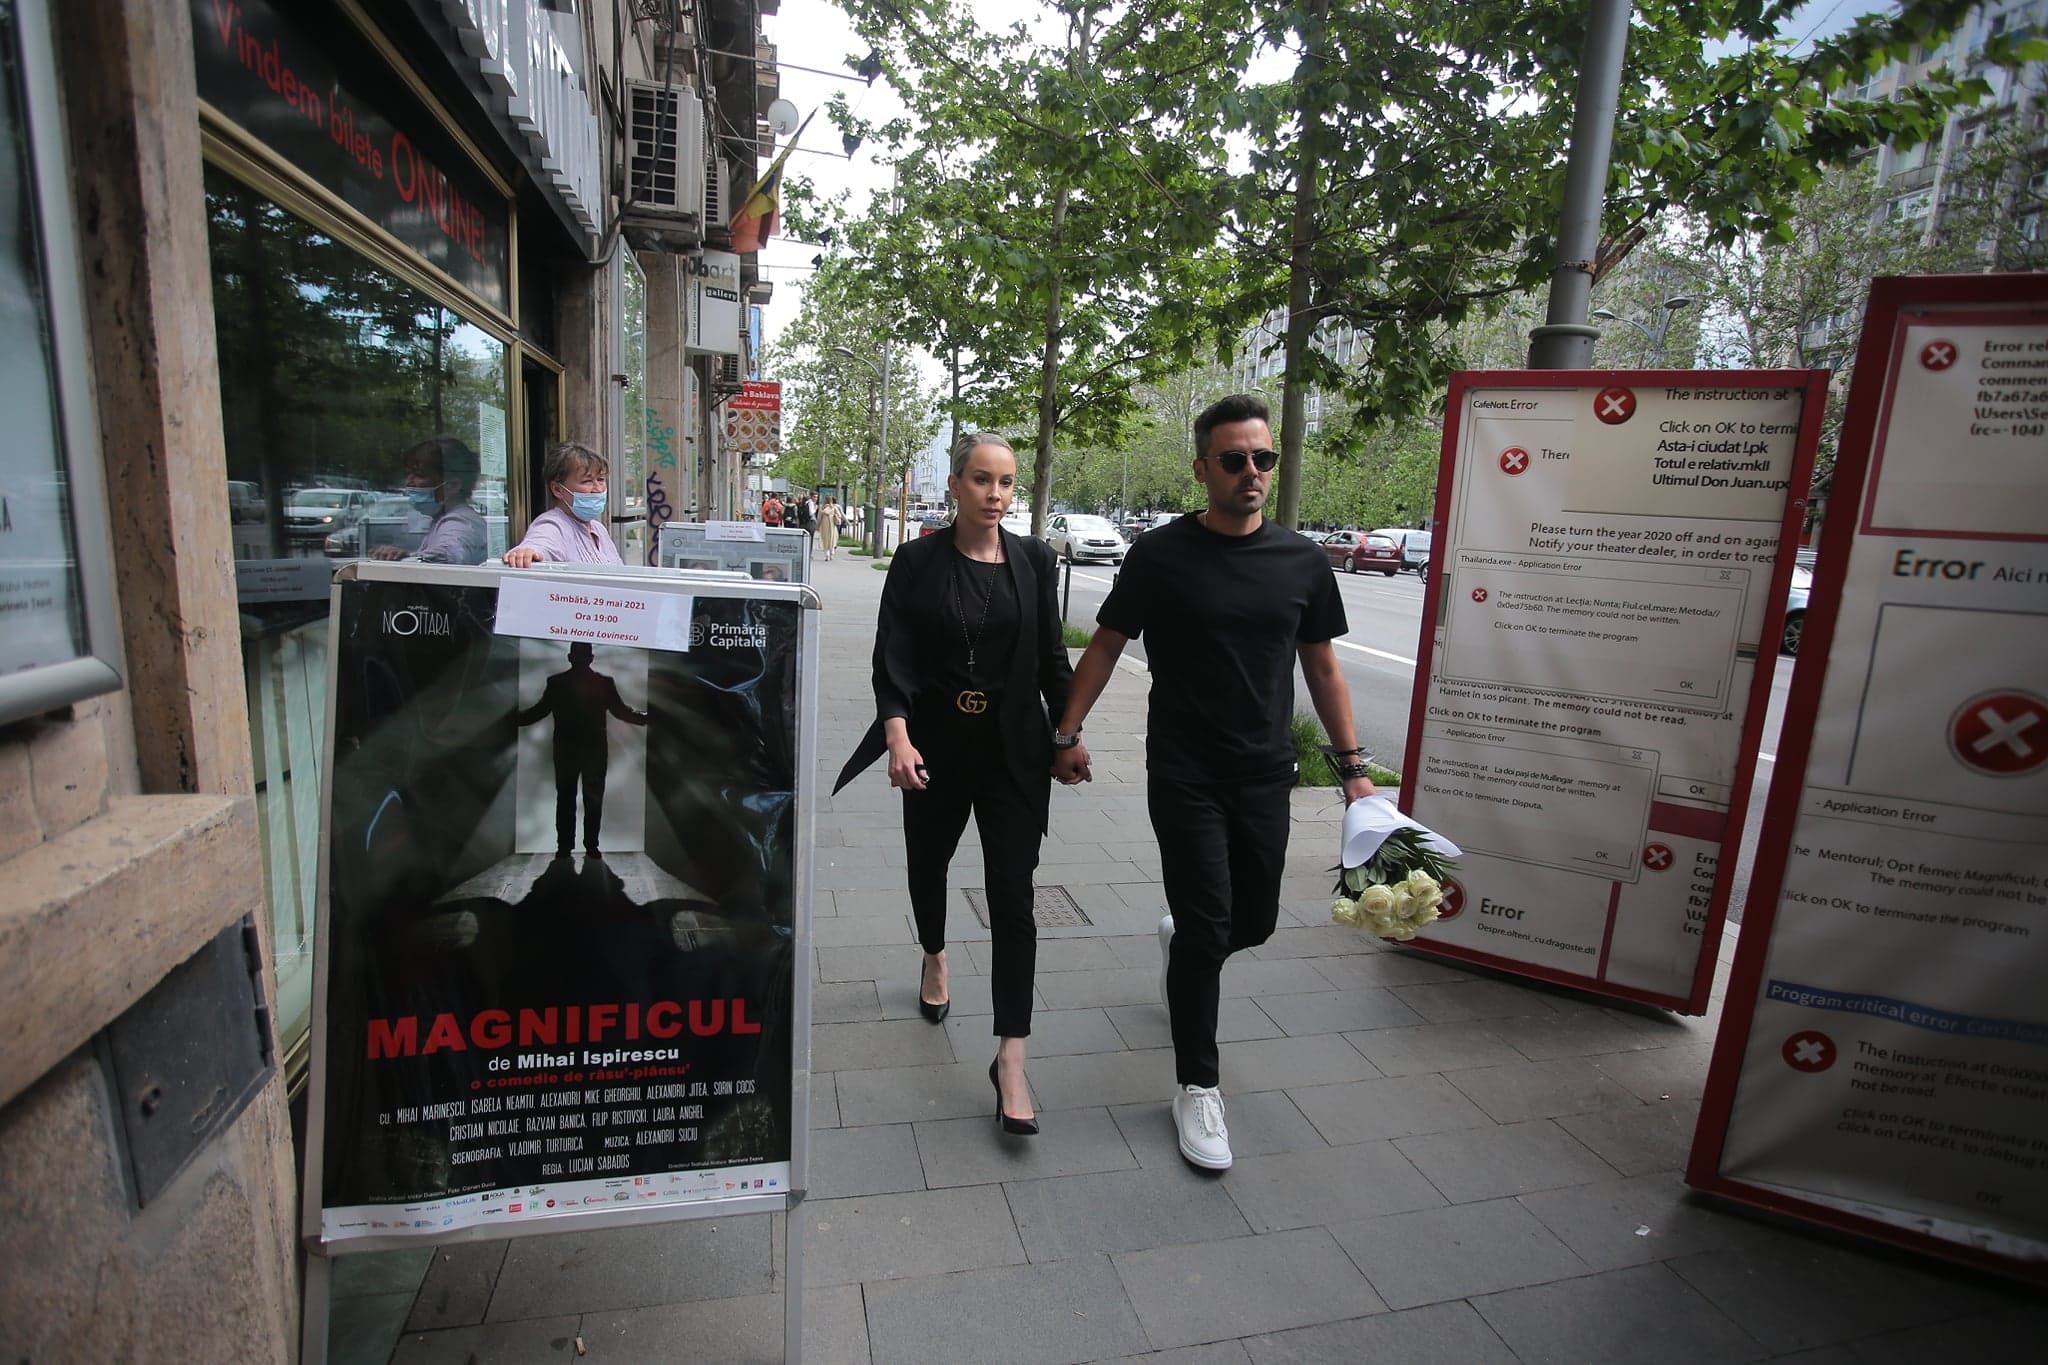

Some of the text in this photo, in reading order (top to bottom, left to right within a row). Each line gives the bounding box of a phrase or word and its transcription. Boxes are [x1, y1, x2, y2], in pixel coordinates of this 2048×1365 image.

[212, 0, 322, 127] Vindem
[330, 91, 383, 179] bilete
[707, 289, 737, 301] gallery
[1985, 340, 2024, 353] Error
[1665, 388, 1789, 400] The instruction at
[1659, 421, 1755, 434] Click on OK to
[1657, 440, 1696, 452] Asta-i
[1654, 458, 1697, 469] Totul e
[1653, 474, 1729, 487] Ultimul Don
[1531, 523, 1741, 546] Please turn the year 2020 off and on
[1529, 538, 1748, 562] Notify your theater dealer, in order to
[1461, 555, 1582, 571] Thailanda.exe Application Error
[1892, 548, 2032, 583] Error Aici
[593, 598, 604, 606] 29
[607, 600, 623, 608] mai
[624, 601, 645, 610] 2021
[1499, 591, 1512, 599] The
[1513, 593, 1553, 602] instruction
[1555, 596, 1563, 604] at
[382, 610, 450, 636] NOTTARA
[575, 612, 618, 623] Ora 19:00
[1547, 606, 1561, 614] The
[1562, 609, 1594, 618] memory
[1597, 610, 1619, 619] could
[1621, 613, 1635, 621] not
[1637, 614, 1647, 622] be
[550, 626, 639, 641] Sala Horia Lovinescu
[711, 623, 766, 636] Primăria
[1494, 621, 1512, 630] Click
[1525, 624, 1537, 633] OK
[1549, 627, 1586, 638] terminate
[1588, 631, 1601, 639] the
[1602, 633, 1638, 642] program
[710, 636, 766, 649] Capitalei
[1680, 681, 1694, 690] OK
[1440, 687, 1471, 698] Hamlet
[1472, 691, 1481, 699] in
[1533, 698, 1550, 708] The
[1553, 701, 1591, 714] memory
[1593, 706, 1621, 717] could
[1624, 711, 1641, 720] not
[1644, 712, 1657, 722] be
[1428, 706, 1601, 737] Click on OK to terminate the program
[1446, 728, 1506, 742] Application Error
[1578, 779, 1611, 791] memory
[1689, 785, 1705, 795] OK
[1475, 793, 1509, 805] terminate
[1823, 800, 1937, 824] Application Error
[1596, 851, 1609, 860] OK
[1818, 849, 1885, 869] Mentorul;
[1887, 858, 1915, 874] Opt
[1870, 872, 2024, 902] The memory could not
[1480, 898, 1525, 920] Error
[1811, 895, 2030, 938] on OK to terminate the program
[1770, 984, 1843, 1007] Program
[1845, 997, 1905, 1020] critical
[1909, 1011, 1959, 1031] error
[368, 998, 761, 1060] MAGNIFICUL
[1856, 1040, 1888, 1059] The
[488, 1049, 679, 1071] de Mihai Ispirescu
[470, 1070, 583, 1090] o comedie de
[1854, 1060, 1918, 1083] memory
[397, 1107, 418, 1124] MIHAI
[471, 1096, 501, 1114] ISABELA
[540, 1090, 581, 1108] ALEXANDRU
[585, 1089, 600, 1104] MIKE
[647, 1083, 686, 1100] ALEXANDRU
[713, 1080, 733, 1096] SORIN
[450, 1122, 484, 1142] CRISTIAN
[592, 1110, 609, 1127] FILIP
[652, 1106, 675, 1122] LAURA
[679, 1104, 704, 1120] ANGHEL
[508, 1139, 541, 1157] VLADIMIR
[635, 1128, 675, 1146] ALEXANDRU
[679, 1127, 698, 1143] SUCIU
[569, 1157, 594, 1174] LUCIAN
